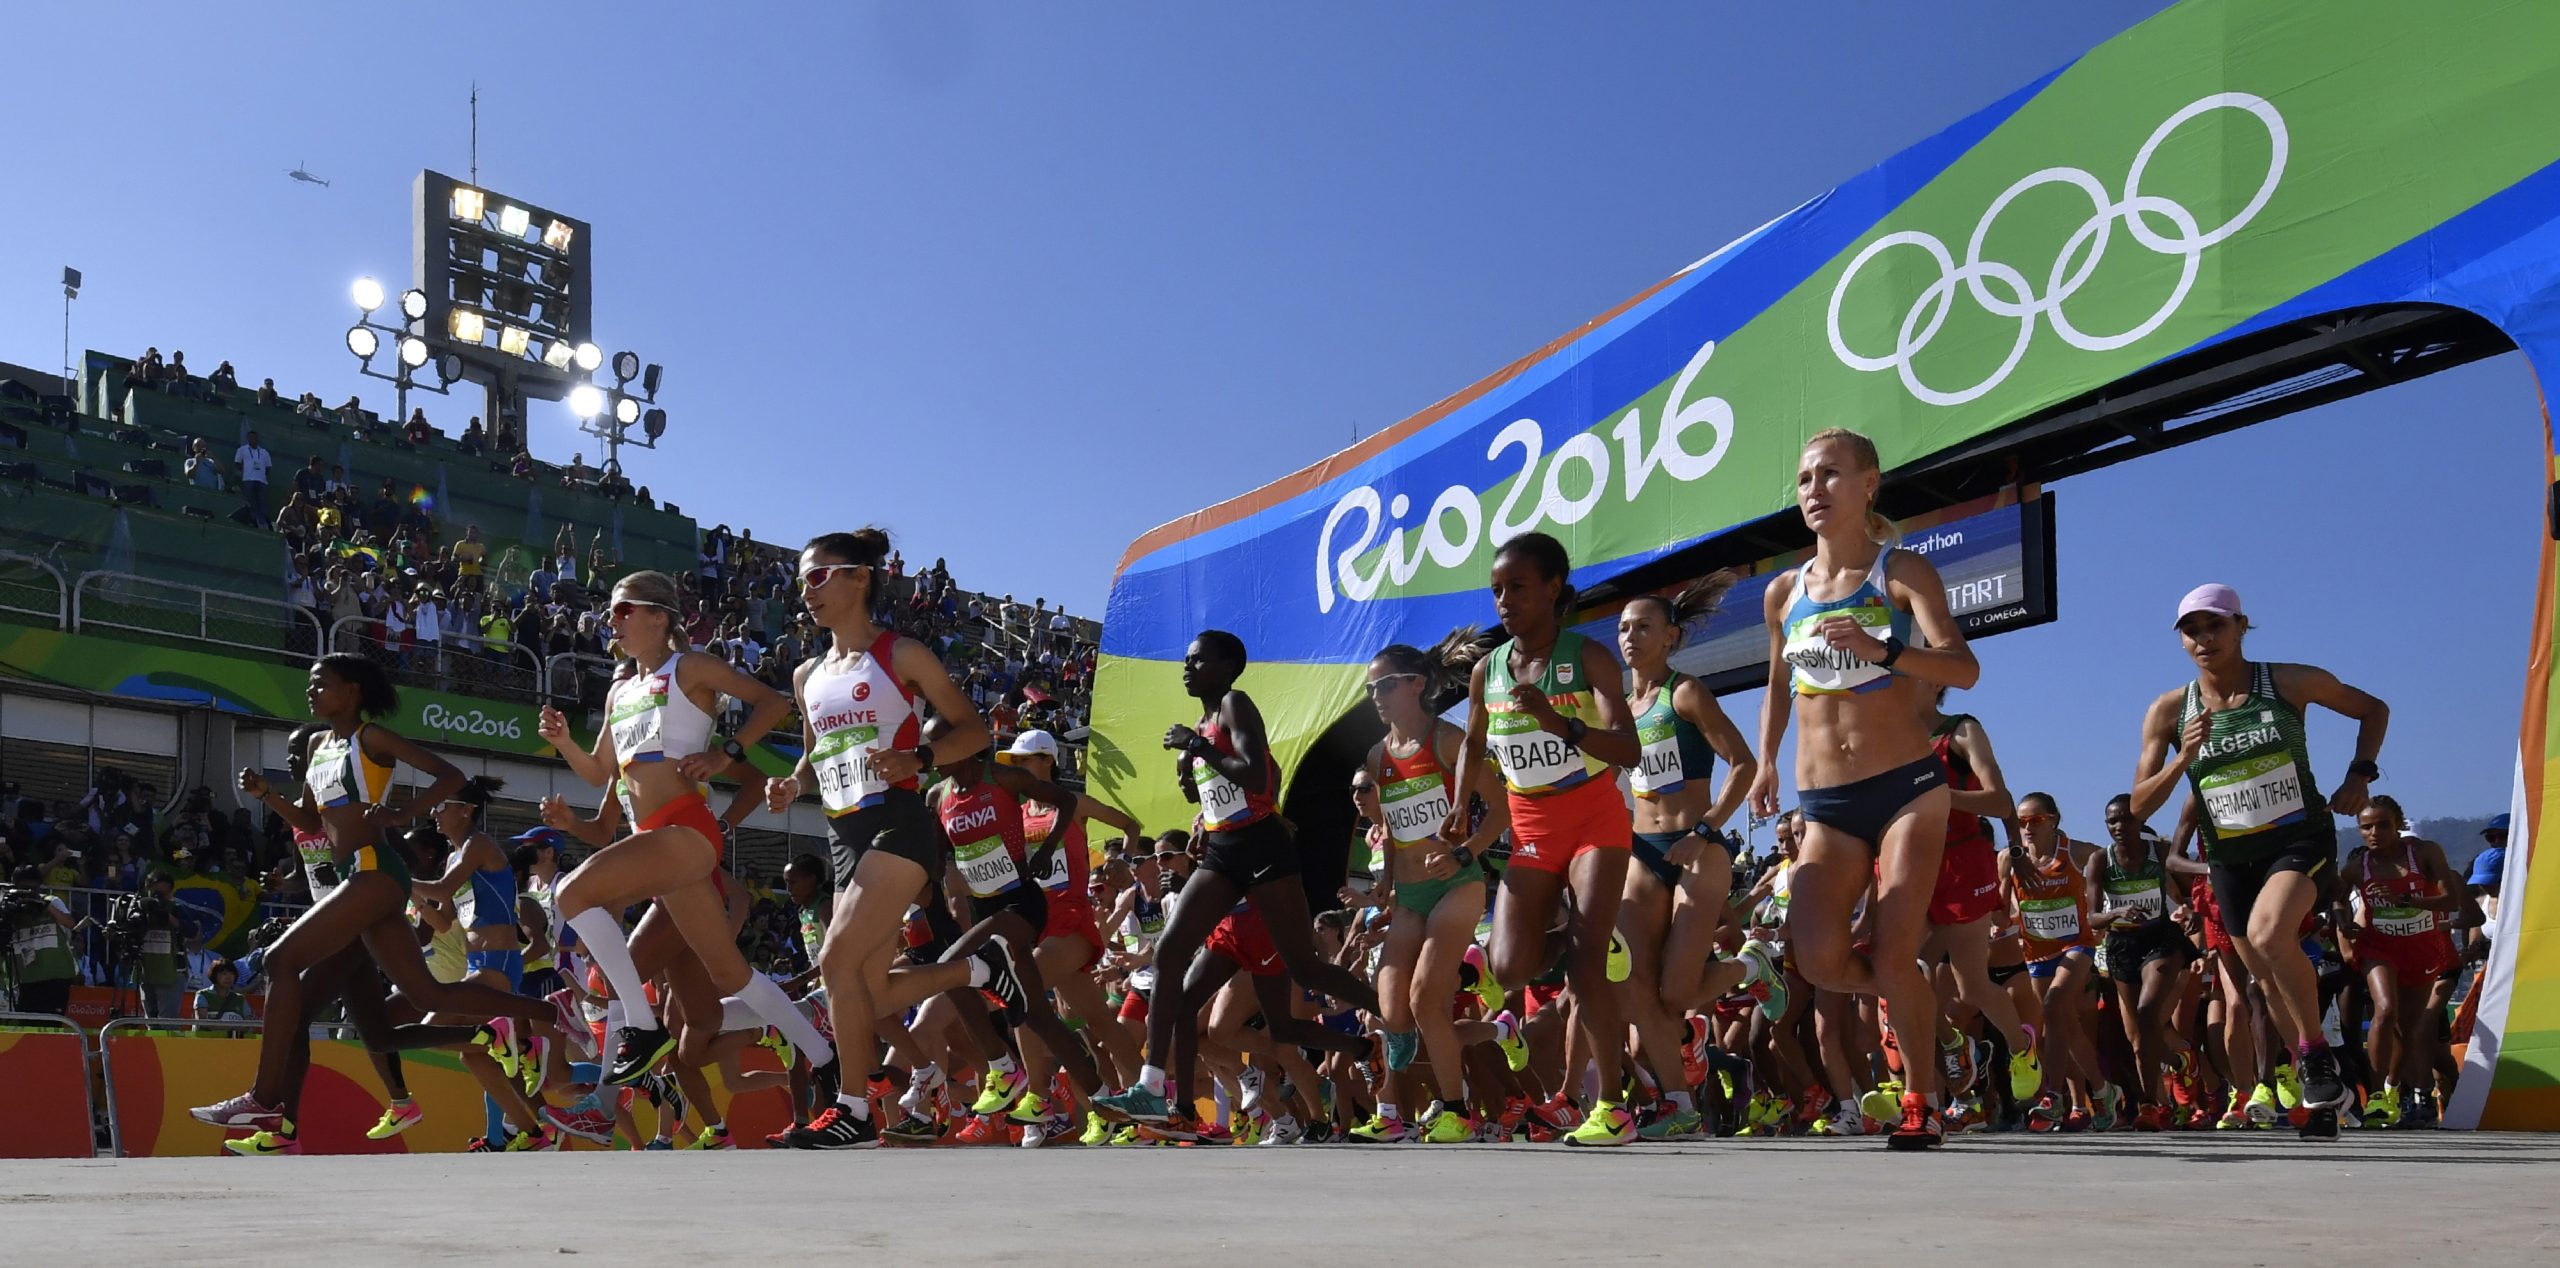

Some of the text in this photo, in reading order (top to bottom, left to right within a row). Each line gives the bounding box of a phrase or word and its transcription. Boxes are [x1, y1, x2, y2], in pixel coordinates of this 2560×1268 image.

[1316, 340, 1734, 613] Rio2016
[1947, 574, 2007, 610] TART
[1984, 607, 2028, 624] OMEGA
[422, 703, 521, 740] Rio2016
[2198, 727, 2282, 760] ALGERIA
[1387, 798, 1449, 830] AUGUSTO
[2207, 776, 2300, 819] DAHMANI TIFAHI
[945, 805, 998, 834] KENYA
[2024, 914, 2078, 931] DEELSTRA
